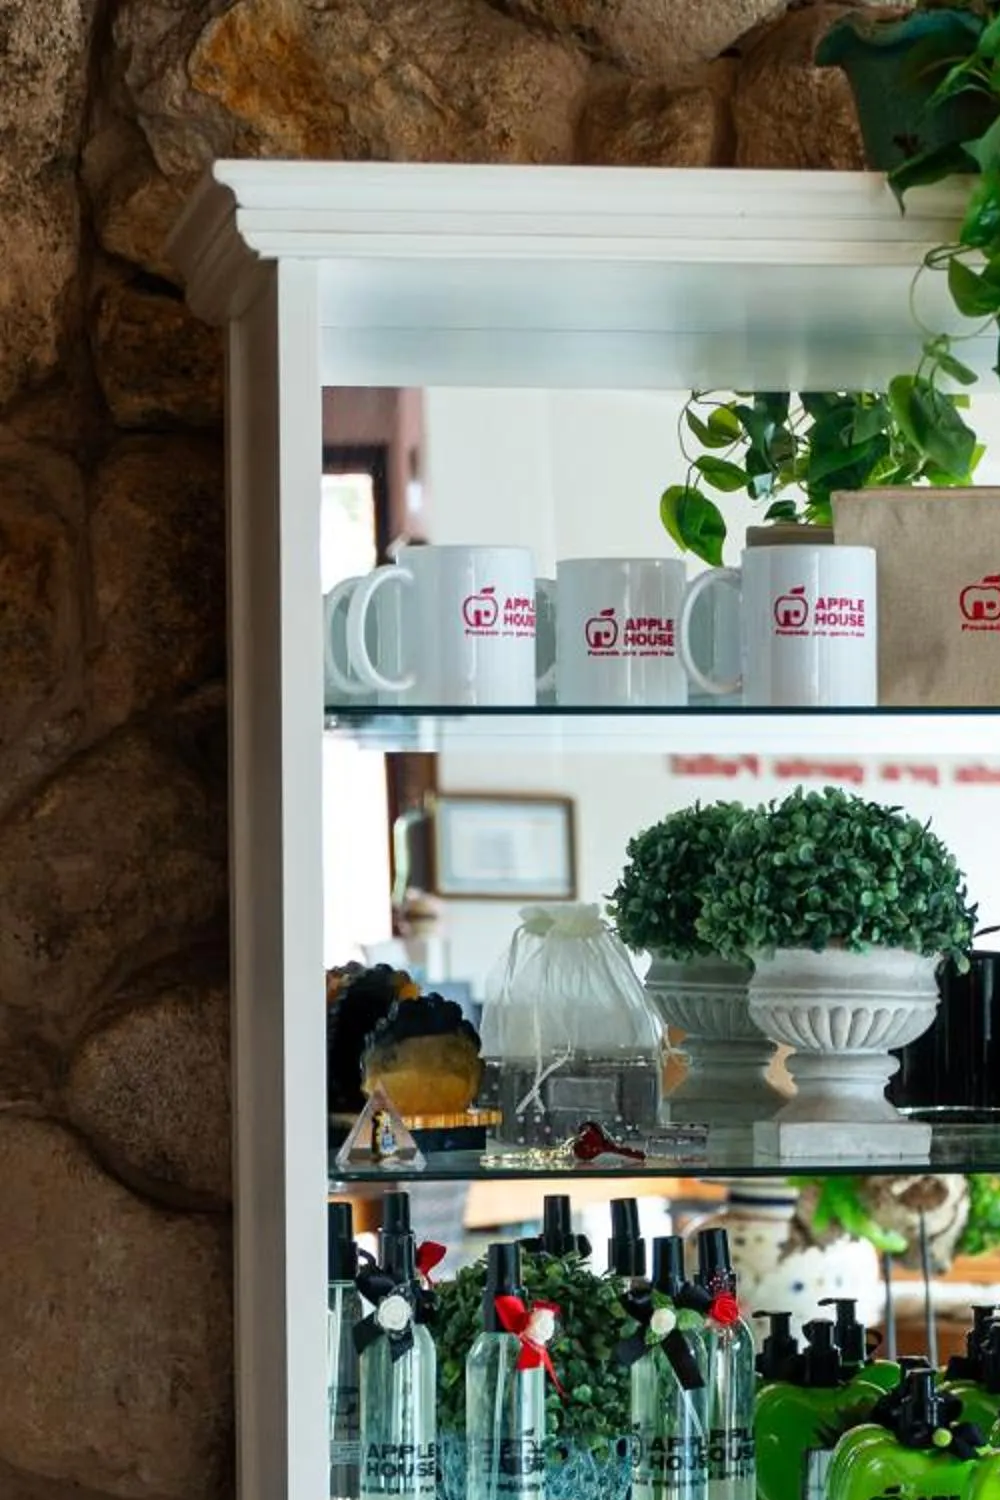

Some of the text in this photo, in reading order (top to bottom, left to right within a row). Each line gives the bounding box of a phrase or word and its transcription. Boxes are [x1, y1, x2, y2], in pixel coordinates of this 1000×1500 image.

[815, 597, 864, 612] APPLE
[624, 617, 674, 632] APPLE
[815, 612, 864, 627] HOUSE
[624, 633, 674, 647] HOUSE
[367, 1443, 435, 1459] APPLE
[367, 1461, 435, 1478] HOUSE
